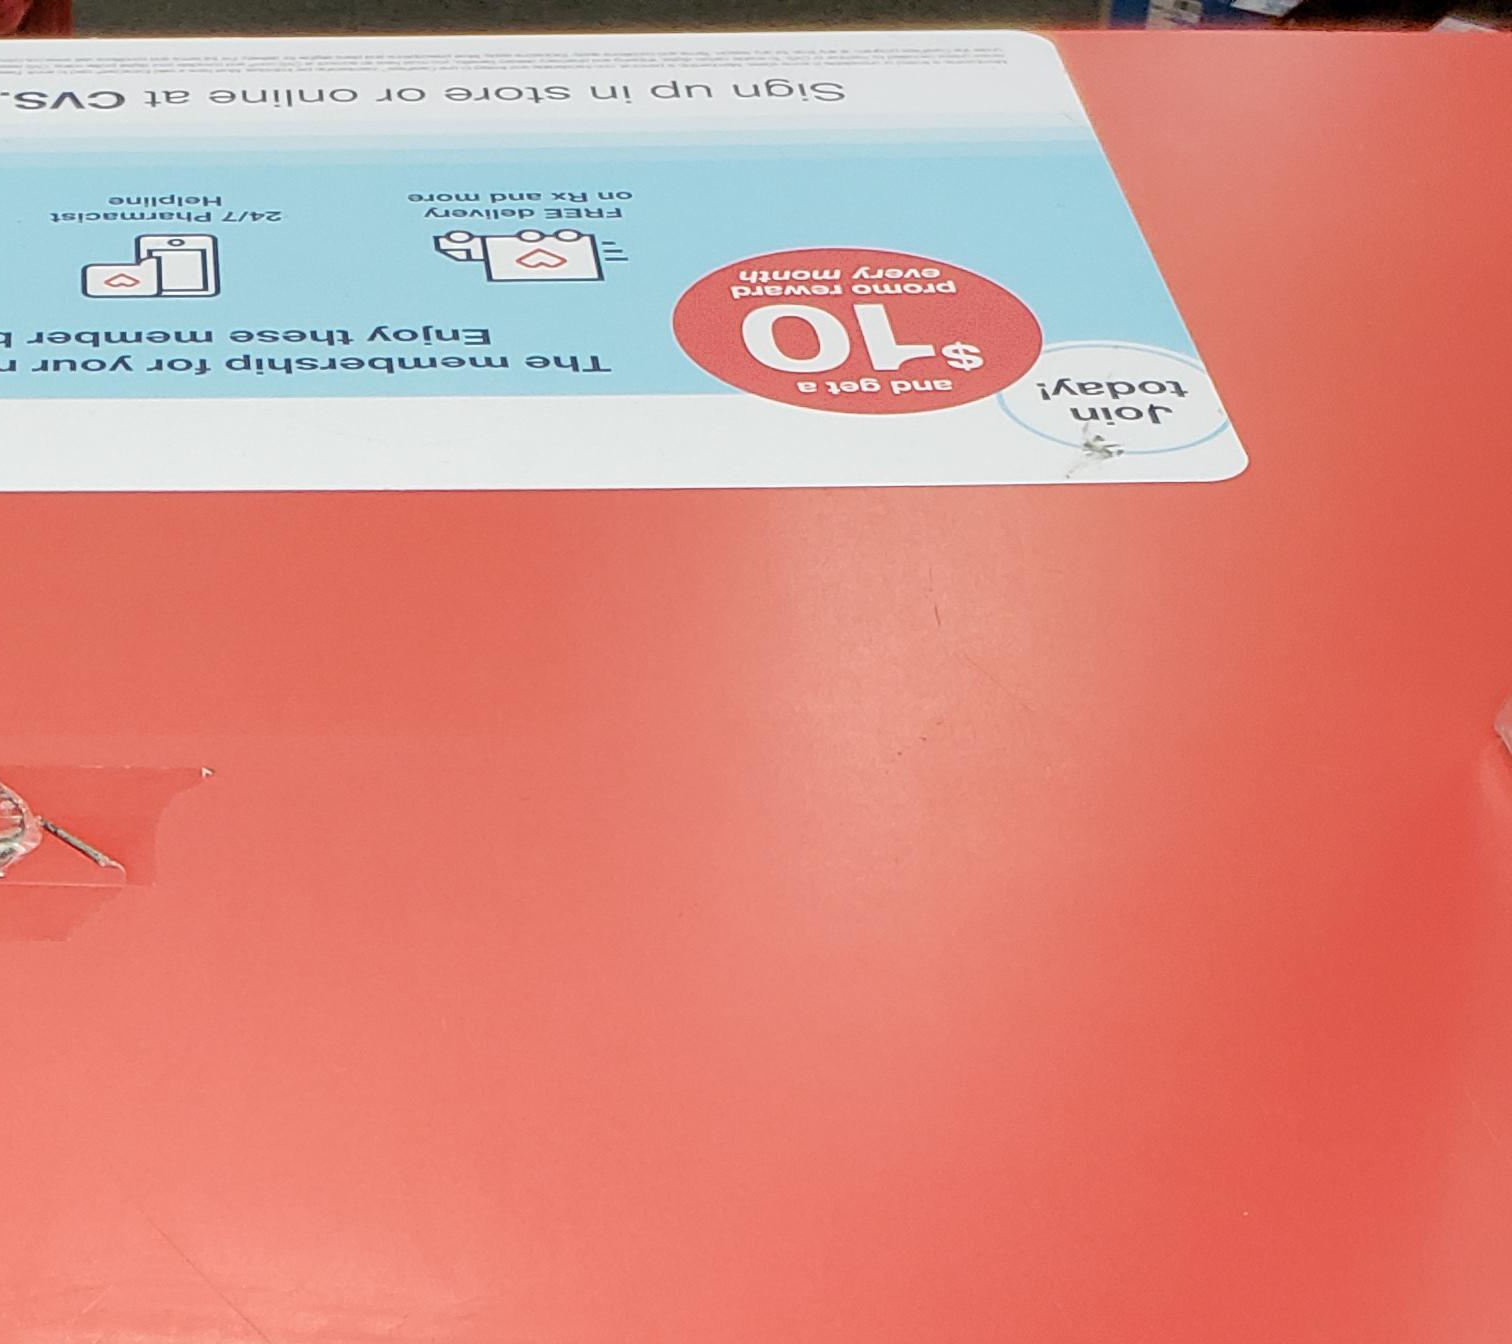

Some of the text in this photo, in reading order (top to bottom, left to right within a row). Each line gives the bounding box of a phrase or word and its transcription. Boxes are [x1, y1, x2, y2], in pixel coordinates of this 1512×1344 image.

[143, 89, 190, 109] at
[208, 87, 358, 108] online
[375, 87, 426, 105] or
[443, 85, 571, 105] store
[589, 85, 631, 104] in
[649, 80, 713, 100] up
[732, 78, 846, 103] Sign
[107, 195, 222, 207] Helpline
[407, 191, 634, 204] on Rx and more
[50, 210, 283, 223] 24/7 Pharmacist
[424, 206, 622, 221] FREE delivery
[738, 266, 940, 283] every month
[730, 280, 957, 299] promo reward
[27, 330, 214, 347] member
[229, 330, 354, 347] these
[367, 325, 492, 346] Enjoy
[32, 355, 133, 375] your
[147, 357, 211, 376] for
[225, 353, 510, 375] membership
[524, 355, 611, 374] The
[796, 377, 953, 394] and get a
[1036, 378, 1188, 400] today!
[1070, 404, 1172, 425] Join
